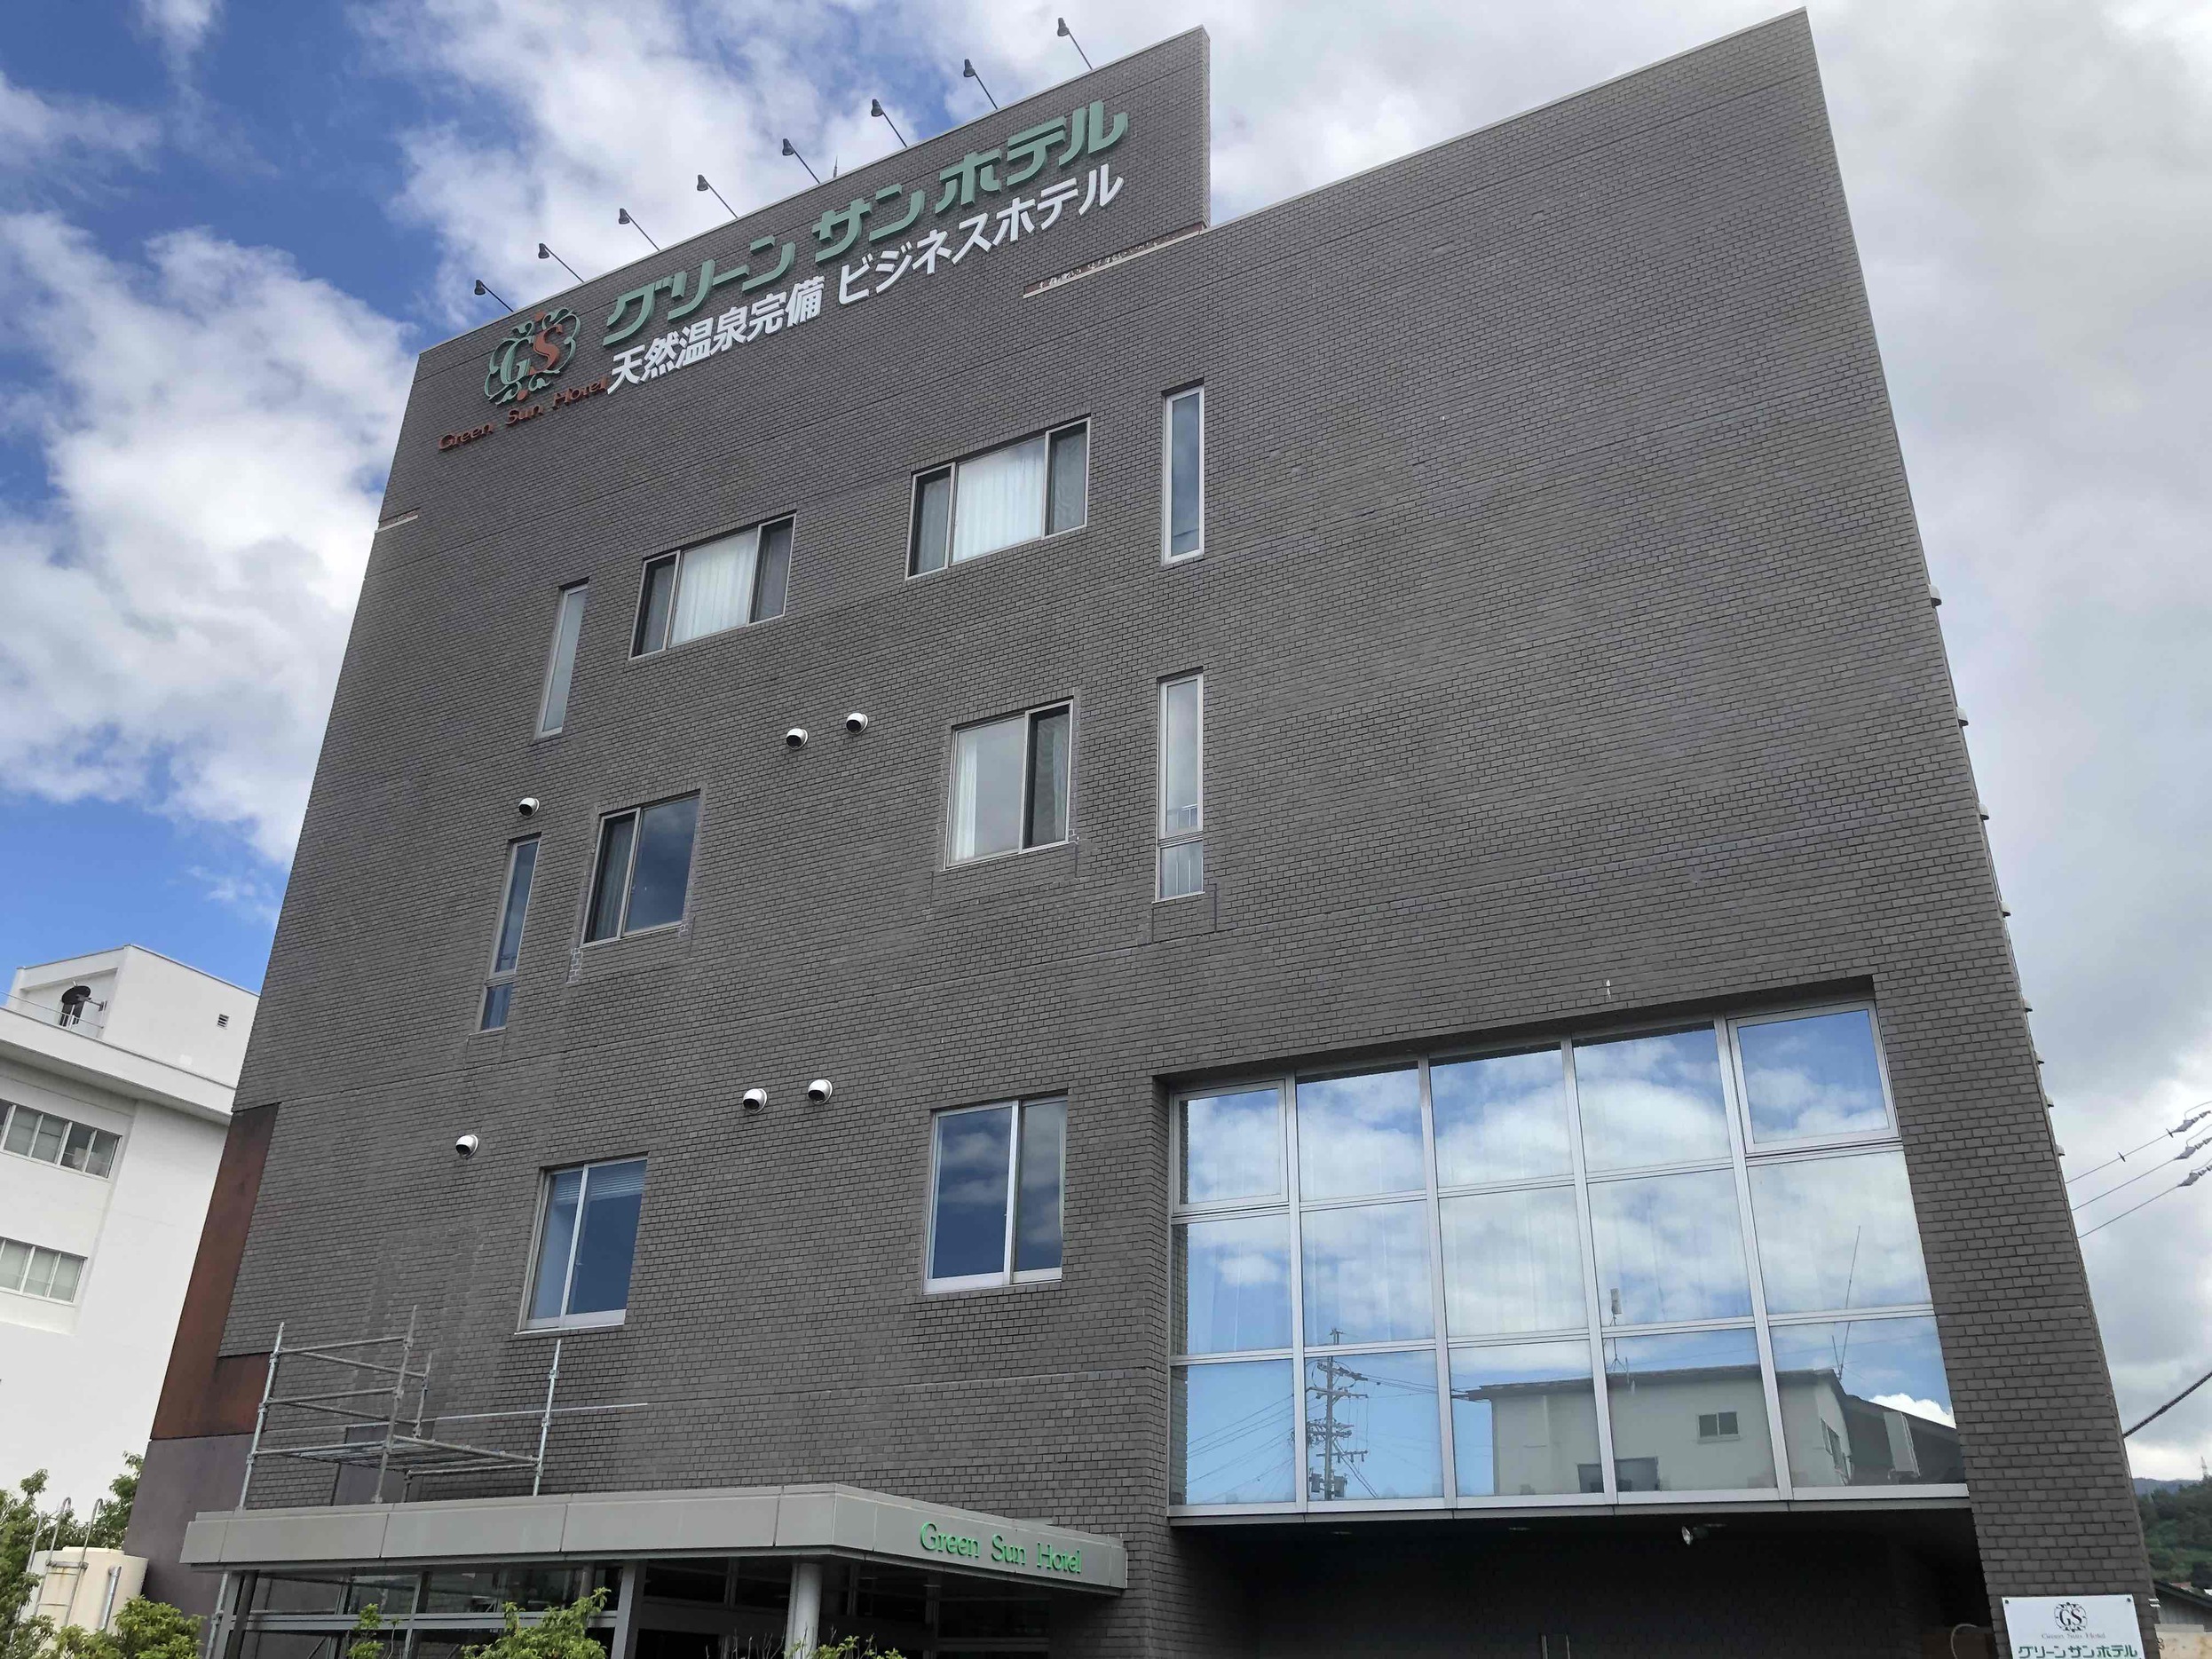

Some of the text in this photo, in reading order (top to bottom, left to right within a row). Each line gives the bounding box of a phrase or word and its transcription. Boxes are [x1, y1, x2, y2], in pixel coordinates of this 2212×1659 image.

[603, 234, 796, 348] グリーン
[934, 99, 1129, 215] ホテル
[607, 163, 1125, 395] 天然温泉完備 ビジネスホテル
[438, 376, 610, 451] Green Sun Hotel
[920, 1521, 1082, 1574] Green Sun Hotel
